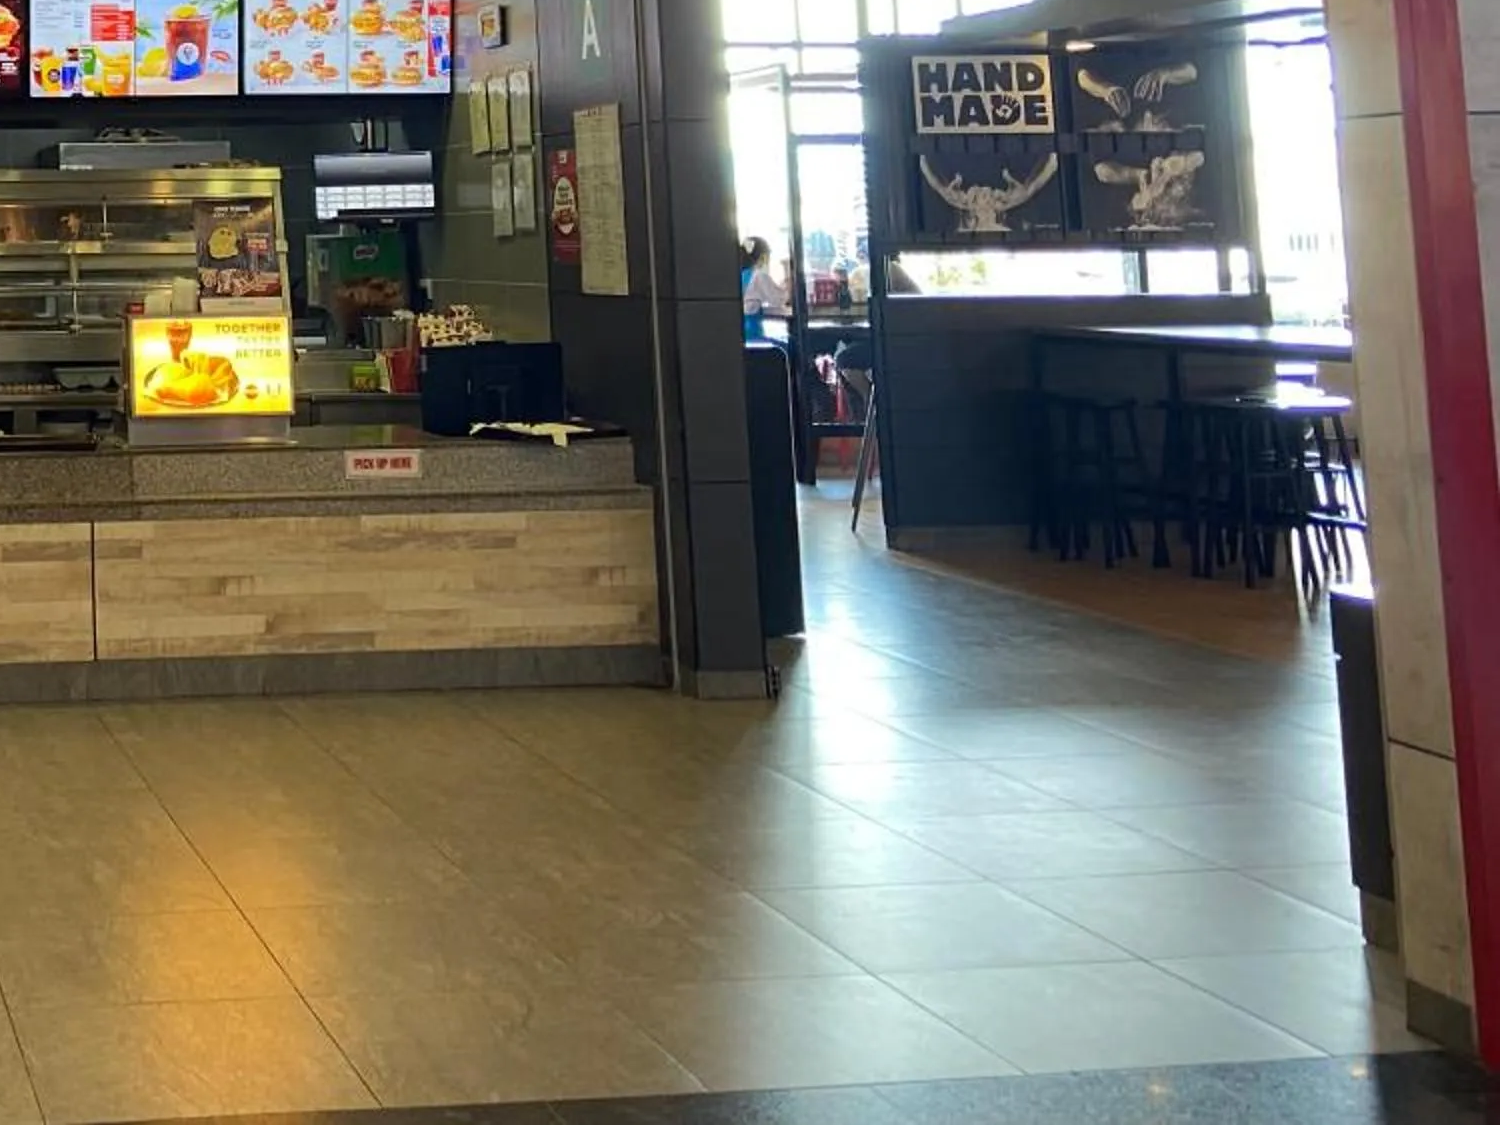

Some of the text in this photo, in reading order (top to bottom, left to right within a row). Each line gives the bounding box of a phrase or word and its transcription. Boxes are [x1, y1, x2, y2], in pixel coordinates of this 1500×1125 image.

[917, 62, 1047, 94] HAND
[920, 93, 1053, 127] MADE
[215, 322, 281, 334] TOGETHER
